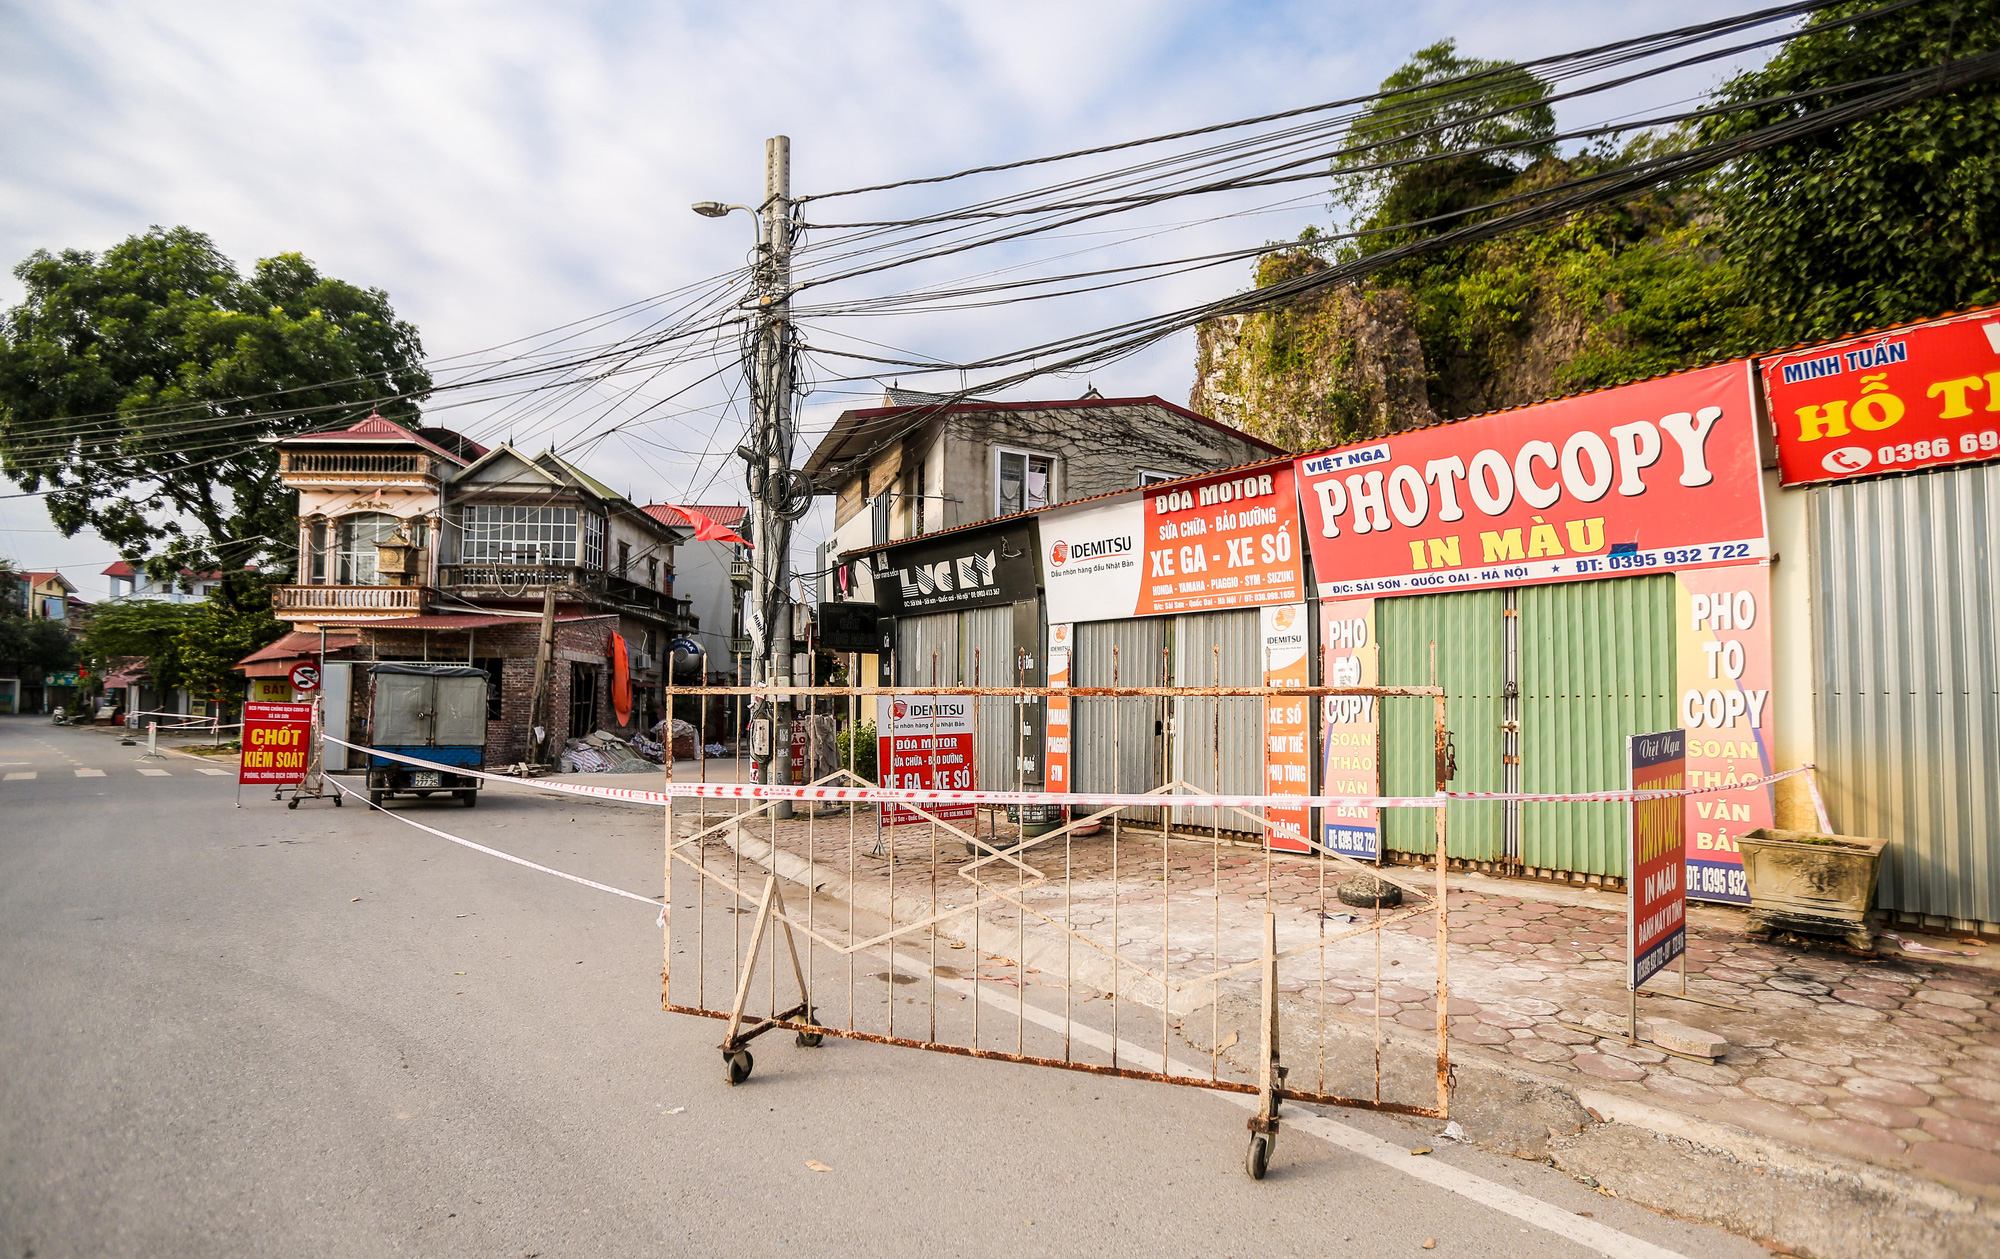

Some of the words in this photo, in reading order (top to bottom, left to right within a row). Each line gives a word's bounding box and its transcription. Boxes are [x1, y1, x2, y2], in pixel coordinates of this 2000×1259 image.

[1783, 355, 1841, 384] MINH
[1847, 336, 1907, 371] TUẤN
[1794, 372, 1905, 442] HỖ
[1877, 438, 1950, 466] 0386
[1959, 430, 2000, 454] 69
[1306, 457, 1349, 474] VIỆT
[1352, 448, 1386, 466] NGA
[1313, 405, 1722, 539] PHOTOCOPY
[1155, 490, 1194, 514] ĐÓA
[1198, 475, 1274, 506] MOTOR
[1159, 515, 1178, 541] SỬA
[1180, 517, 1206, 538] CHỮA
[1216, 510, 1238, 534] BẢO
[1239, 506, 1276, 528] DƯỠNG
[1071, 536, 1132, 559] IDEMITSU
[1150, 550, 1174, 578] XE
[1180, 544, 1206, 573] GA
[1226, 537, 1254, 568] XE
[1261, 520, 1291, 564] SỐ
[1409, 535, 1462, 571] IN
[1480, 516, 1606, 564] MÀU
[1576, 558, 1604, 574] ĐT:
[1608, 551, 1657, 570] 0395
[1663, 548, 1703, 566] 932
[1708, 543, 1750, 560] 722
[1152, 584, 1174, 596] HONDA
[1178, 581, 1205, 594] YAMAHA
[1211, 578, 1239, 590] PIAGGIO
[1244, 574, 1261, 586] SYM
[1267, 571, 1294, 584] SUZUKI
[1332, 585, 1353, 594] Đ/C:
[1356, 580, 1374, 592] SÀI
[1378, 579, 1400, 590] SƠN
[1411, 574, 1444, 586] QUỐC
[1448, 573, 1470, 584] OAI
[1482, 569, 1500, 580] HÀ
[1504, 567, 1528, 580] NỘI
[1692, 590, 1756, 630] PHO
[1267, 635, 1302, 645] IDEMITSU
[1329, 618, 1366, 649] PHO
[1703, 640, 1744, 680] TO
[910, 704, 964, 717] IDEMITSU
[1270, 708, 1283, 724] XE
[1286, 702, 1302, 724] SỐ
[1325, 694, 1374, 724] COPY
[1682, 689, 1768, 729] COPY
[251, 724, 302, 745] CHỐT
[896, 738, 918, 750] ĐÓA
[1289, 731, 1304, 753] THẾ
[1330, 732, 1372, 750] SOẠN
[244, 745, 272, 768] KIỂM
[276, 749, 304, 768] SOÁT
[905, 755, 923, 766] CHỮA
[928, 755, 941, 765] BO
[942, 753, 963, 764] DƯỠNG
[1331, 752, 1372, 772] THẢO
[1640, 741, 1658, 760] Việt
[1662, 739, 1680, 756] Nga
[1688, 740, 1758, 764] SOẠN
[904, 773, 921, 789] GA
[936, 771, 950, 789] XE
[954, 763, 970, 789] SỐ
[1051, 764, 1062, 781] SYM
[1284, 761, 1306, 783] TÙNG
[1688, 766, 1758, 791] THẢO
[1337, 777, 1368, 795] VĂN
[1696, 798, 1750, 822] VĂN
[1365, 832, 1376, 852] 722
[1645, 874, 1655, 906] IN
[1656, 862, 1677, 899] MÀU
[1686, 865, 1700, 890] ĐT:
[1702, 866, 1726, 893] 0395
[1728, 869, 1748, 896] 932
